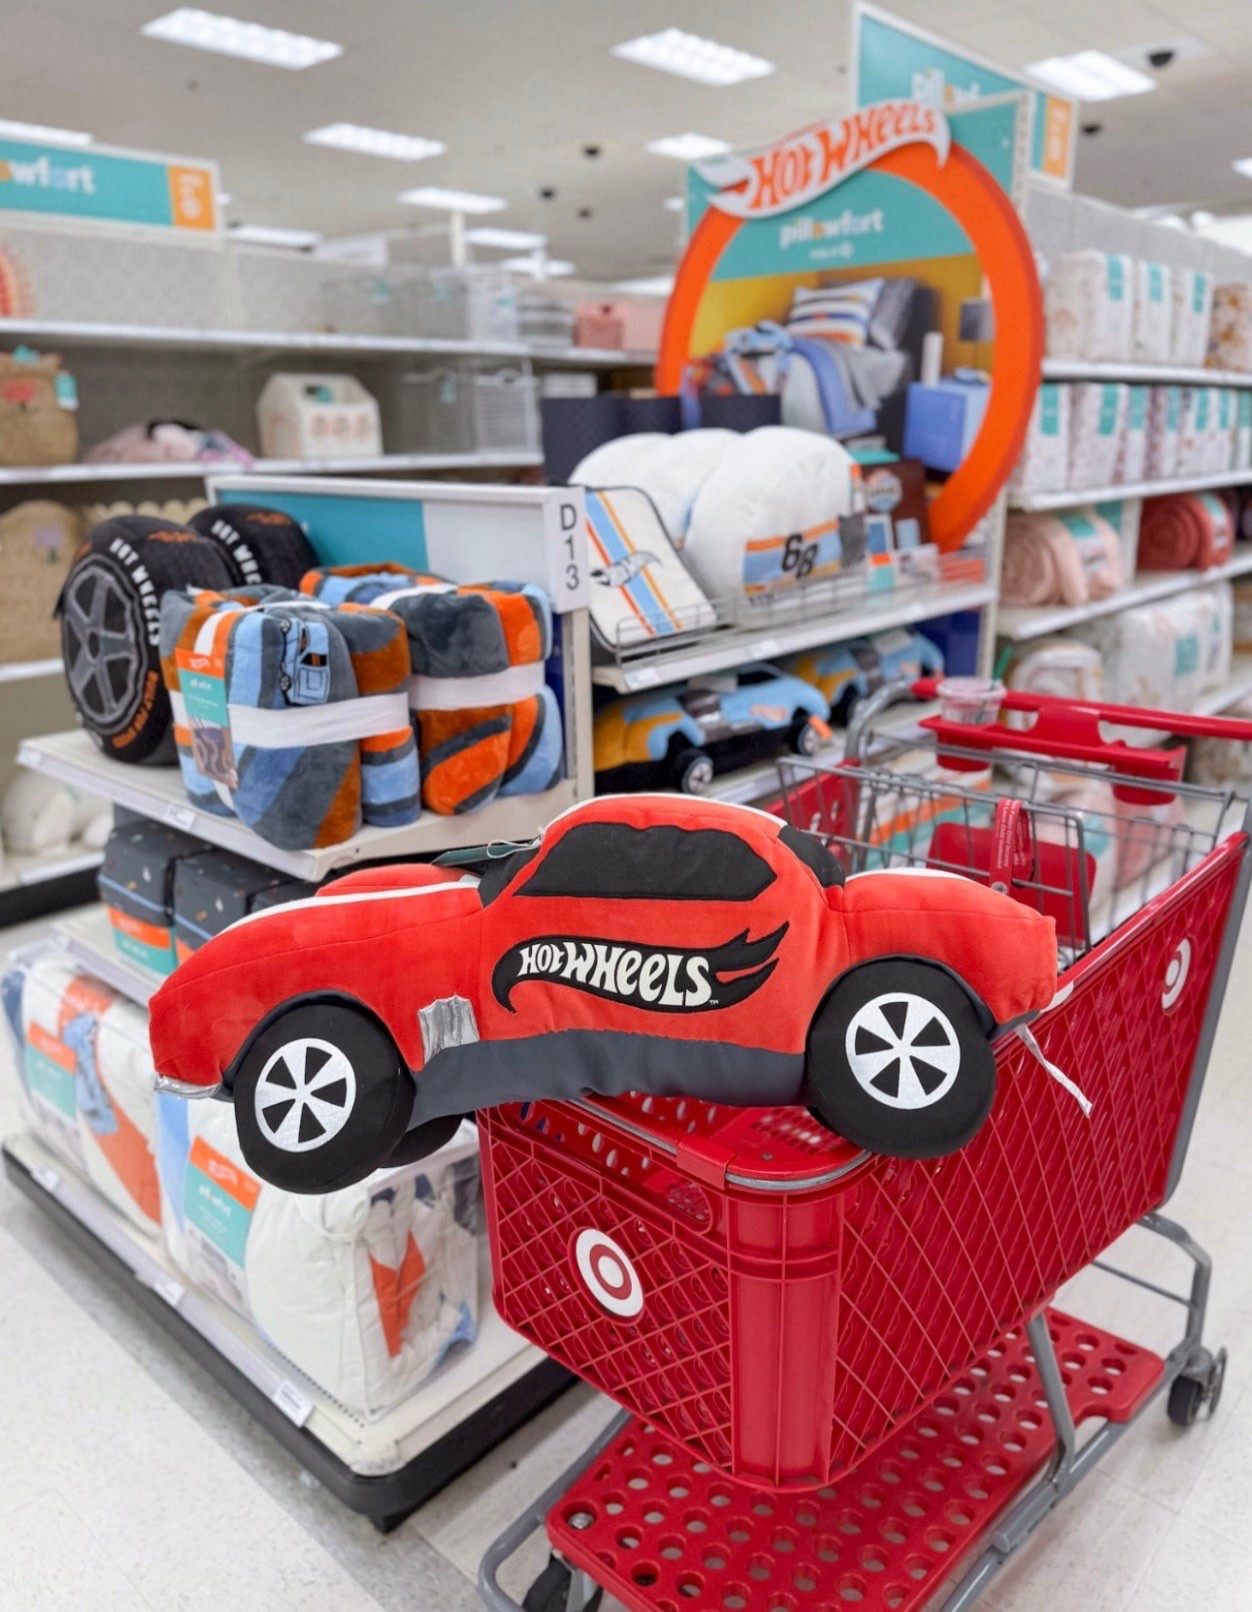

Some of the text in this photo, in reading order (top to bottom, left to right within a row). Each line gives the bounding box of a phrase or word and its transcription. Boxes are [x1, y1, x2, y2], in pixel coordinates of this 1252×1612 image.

[749, 102, 935, 209] HOT WHEELS
[108, 537, 139, 567] HOT
[782, 533, 819, 579] 68
[517, 943, 564, 977] HOT
[560, 942, 712, 1006] WHEELS
